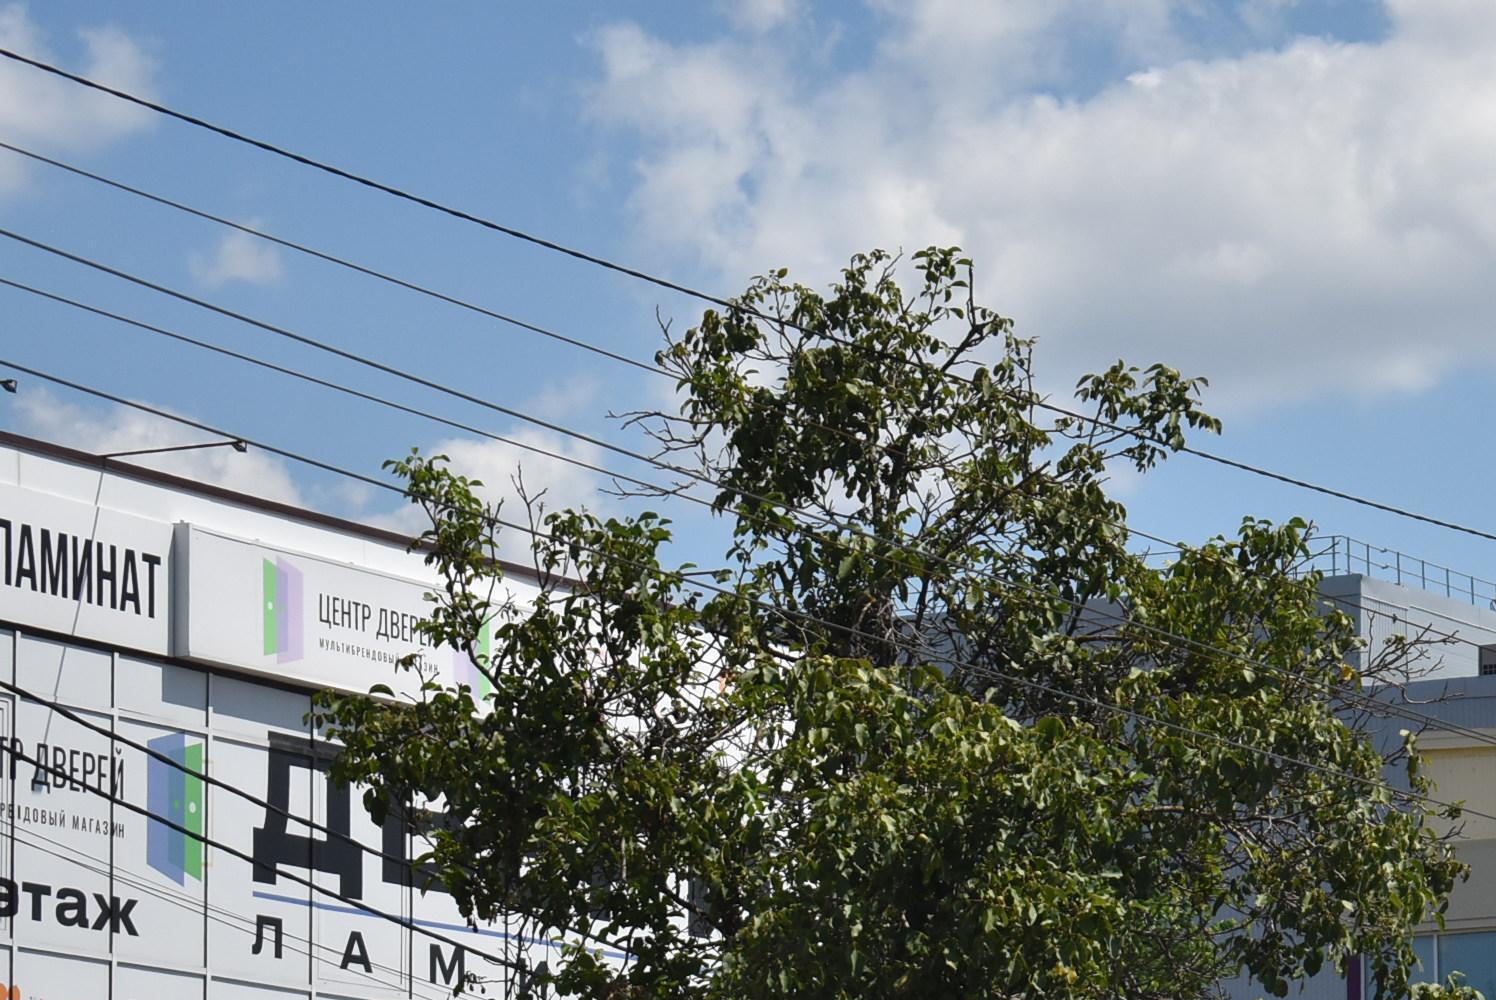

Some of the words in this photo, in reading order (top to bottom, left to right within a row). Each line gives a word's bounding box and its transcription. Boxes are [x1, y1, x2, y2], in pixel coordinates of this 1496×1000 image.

[319, 593, 371, 632] ЦЕНТР
[376, 607, 441, 648] ДВЕРЕ
[31, 742, 125, 801] ДВЕРЕЙ
